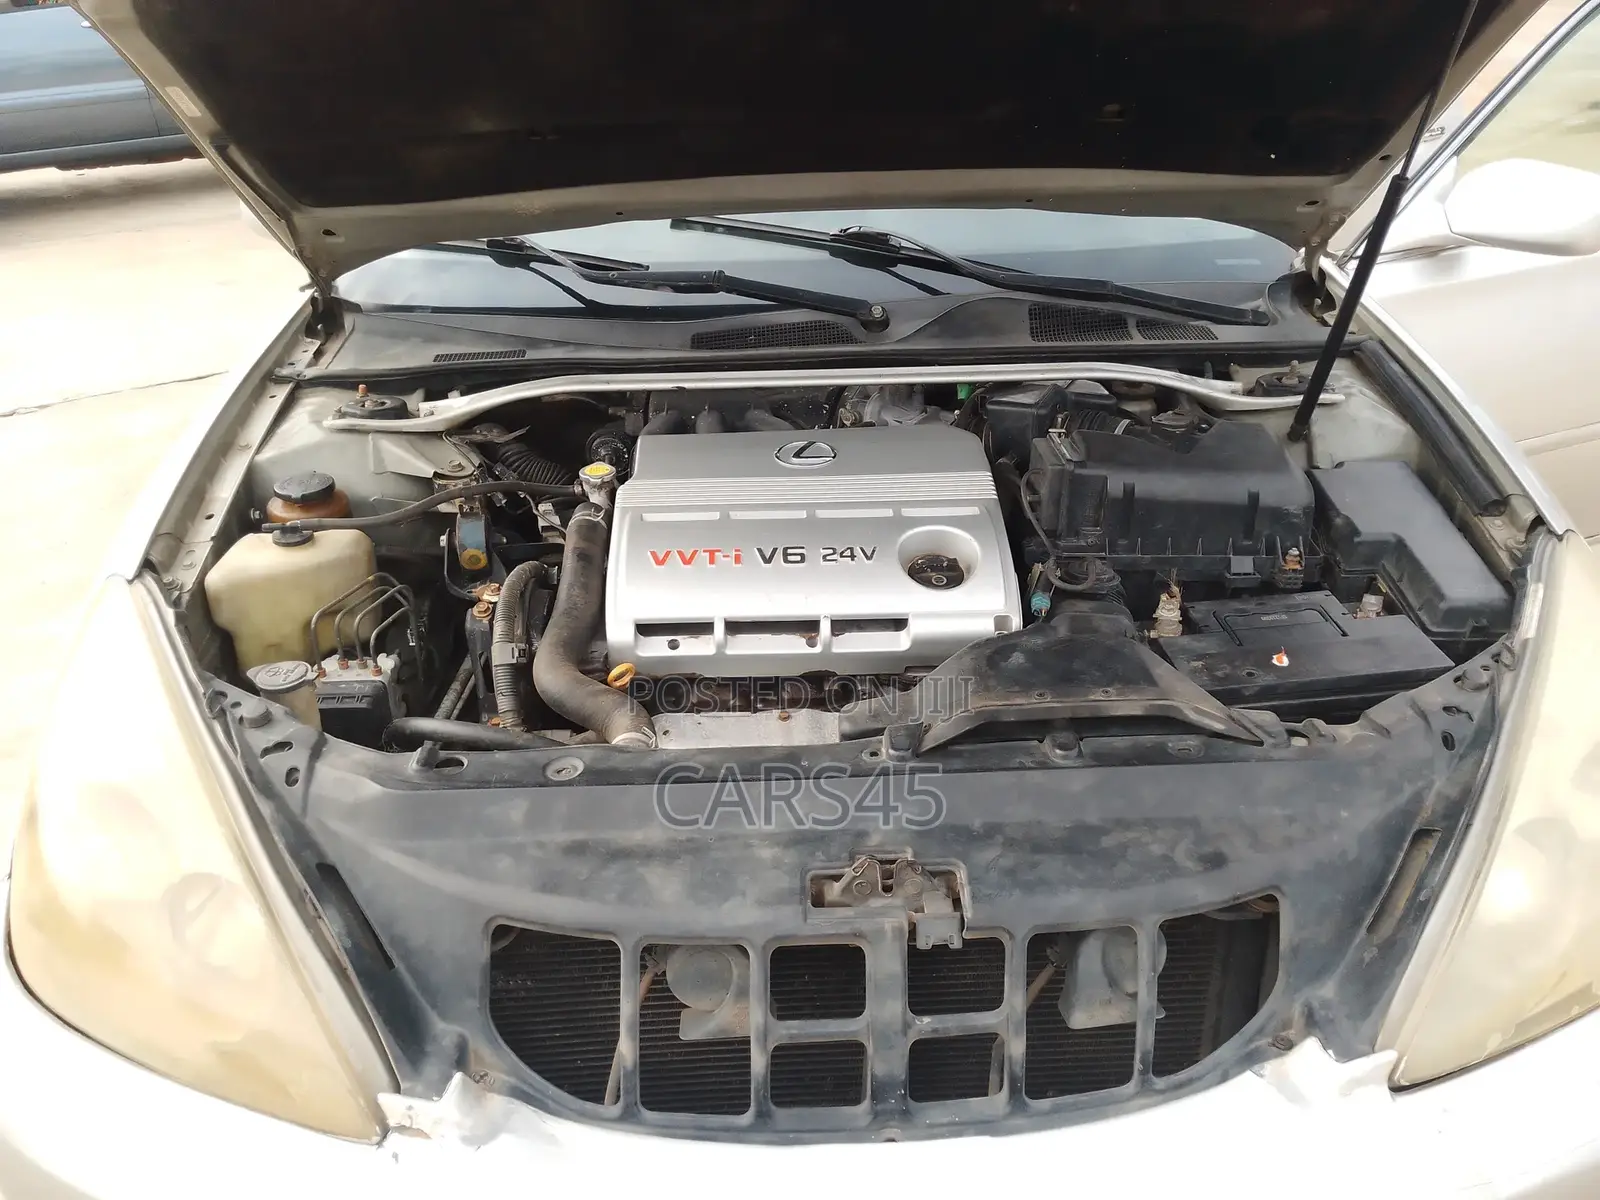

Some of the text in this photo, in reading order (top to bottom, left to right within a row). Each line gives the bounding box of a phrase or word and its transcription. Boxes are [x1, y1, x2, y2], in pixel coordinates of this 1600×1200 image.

[648, 545, 877, 567] VVT-i V6 24V
